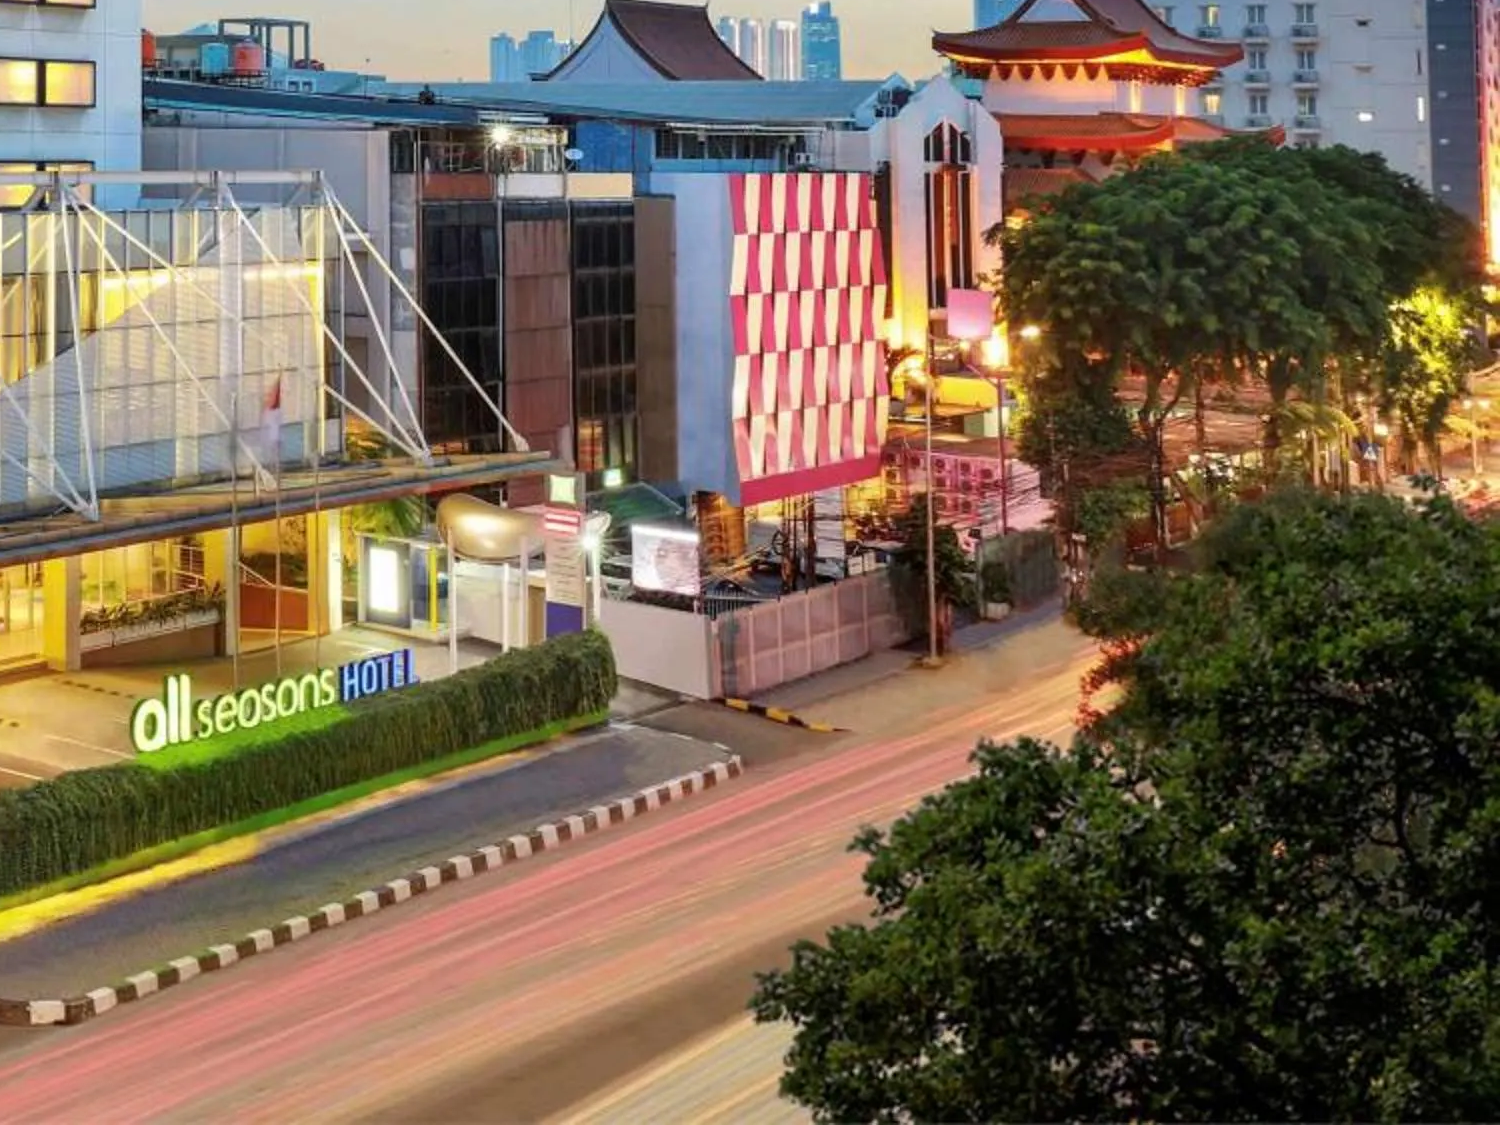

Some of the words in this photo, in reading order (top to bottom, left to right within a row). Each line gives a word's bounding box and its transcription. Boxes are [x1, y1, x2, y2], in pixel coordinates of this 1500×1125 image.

[132, 673, 193, 752] all
[196, 668, 336, 739] seasons
[340, 649, 417, 703] HOTEL
